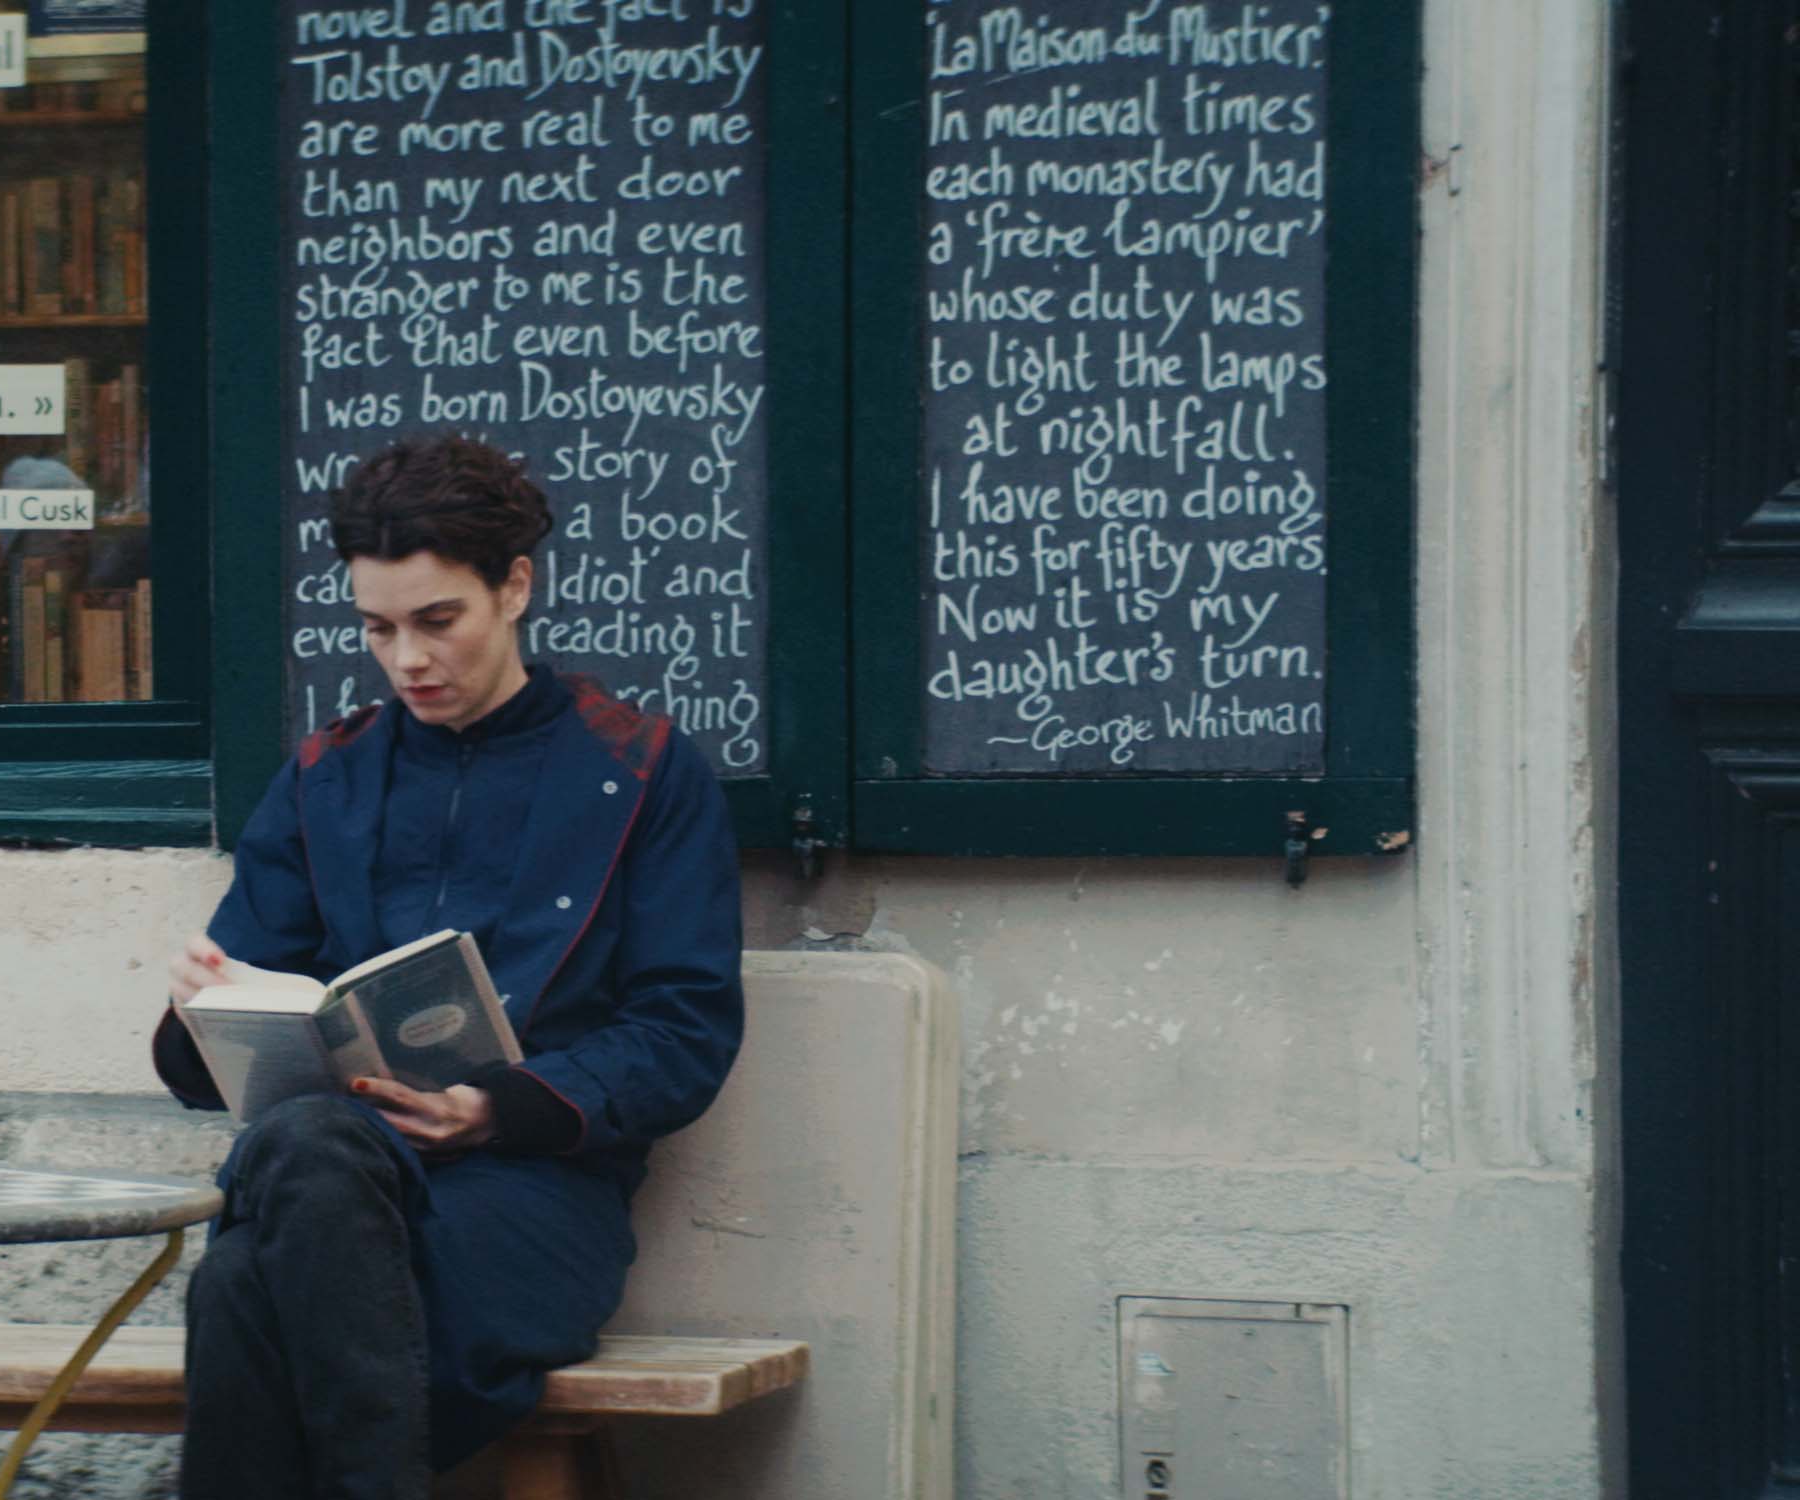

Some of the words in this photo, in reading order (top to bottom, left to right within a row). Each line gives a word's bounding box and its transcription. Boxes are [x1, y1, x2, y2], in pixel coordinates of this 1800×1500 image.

[297, 0, 414, 44] novel
[425, 0, 506, 36] and
[524, 0, 596, 29] the
[600, 0, 689, 41] fact
[981, 7, 1107, 74] Maison
[1114, 10, 1161, 58] du
[292, 45, 451, 119] Tolstoy
[458, 32, 529, 91] and
[526, 26, 763, 109] Dostoyevsky
[299, 120, 379, 159] are
[399, 119, 505, 157] more
[522, 96, 611, 149] real
[631, 95, 674, 148] to
[688, 112, 754, 148] me
[930, 90, 969, 147] In
[984, 77, 1161, 140] medieval
[1182, 73, 1316, 136] times
[302, 168, 400, 218] than
[425, 176, 483, 225] my
[501, 154, 599, 203] next
[617, 156, 743, 201] door
[926, 145, 1015, 202] each
[1027, 138, 1235, 219] monastery
[1245, 139, 1326, 201] had
[297, 215, 514, 292] neighbors
[533, 208, 616, 257] and
[637, 221, 746, 258] even
[929, 221, 953, 265] a
[296, 268, 479, 345] stranger
[494, 264, 530, 313] to
[542, 268, 594, 306] me
[605, 261, 643, 306] is
[662, 257, 749, 306] the
[929, 266, 1056, 323] whose
[1069, 263, 1195, 348] duty
[1211, 286, 1304, 328] was
[300, 321, 392, 384] fact
[412, 314, 503, 368] that
[513, 322, 611, 359] even
[628, 310, 765, 374] before
[930, 335, 973, 392] to
[986, 330, 1098, 416] light
[1115, 330, 1187, 389] the
[1200, 332, 1328, 417] lamps
[299, 385, 311, 433] I
[326, 392, 402, 430] was
[421, 372, 508, 424] born
[519, 361, 766, 446] Dostoyevsky
[963, 402, 1019, 456] at
[1040, 395, 1296, 485] nightfall.
[548, 428, 671, 500] story
[688, 423, 737, 493] of
[930, 466, 941, 528] I
[960, 461, 1062, 525] have
[1073, 466, 1168, 519] been
[1182, 465, 1323, 535] doing
[19, 496, 89, 521] Cusk
[566, 503, 593, 541] a
[621, 492, 749, 543] book
[664, 548, 756, 601] and
[933, 529, 1019, 581] this
[1031, 524, 1091, 595] for
[1096, 522, 1193, 600] fifty
[1198, 534, 1328, 593] years.
[528, 609, 700, 681] reading
[710, 602, 753, 658] it
[938, 584, 1038, 642] Now
[1054, 576, 1097, 629] it
[1115, 578, 1160, 625] is
[1190, 592, 1280, 649] my
[928, 631, 1177, 721] daughter's
[1200, 634, 1322, 689] turn.
[1164, 691, 1323, 740] Whitman
